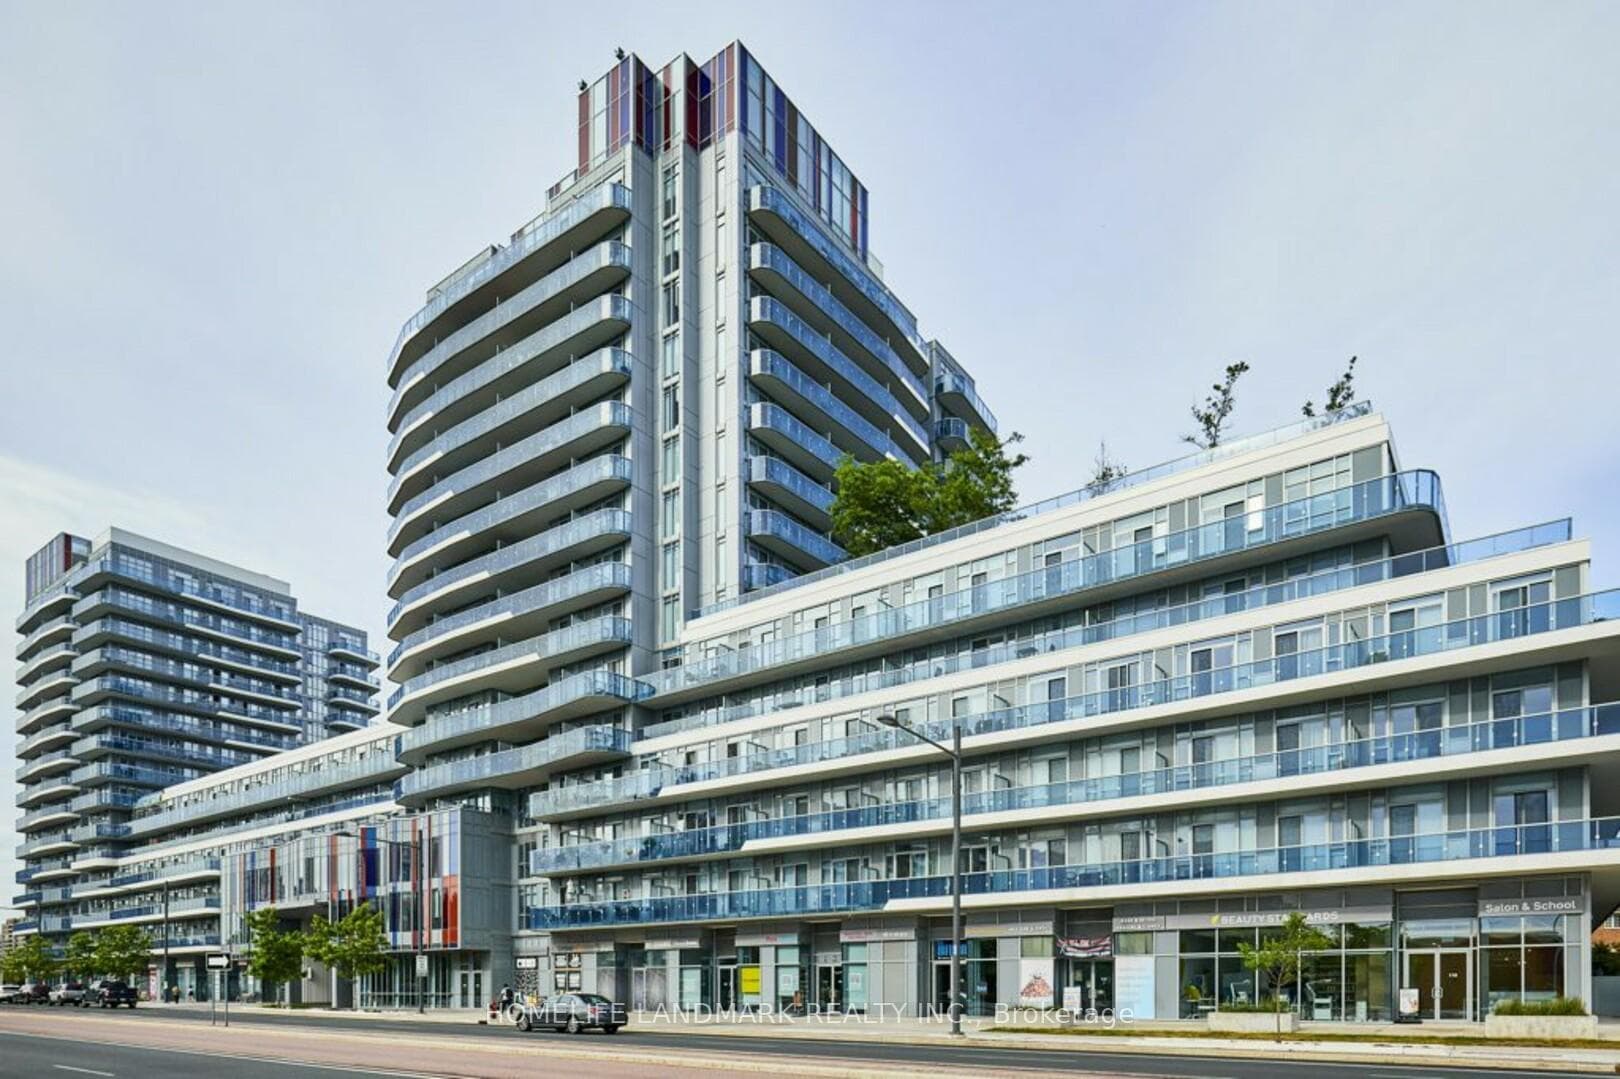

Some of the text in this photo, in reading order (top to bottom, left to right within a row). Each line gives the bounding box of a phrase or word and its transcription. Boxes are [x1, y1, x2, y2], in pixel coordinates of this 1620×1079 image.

[1485, 900, 1576, 913] Salon & School
[1221, 911, 1339, 925] BEAUTY STAARDS
